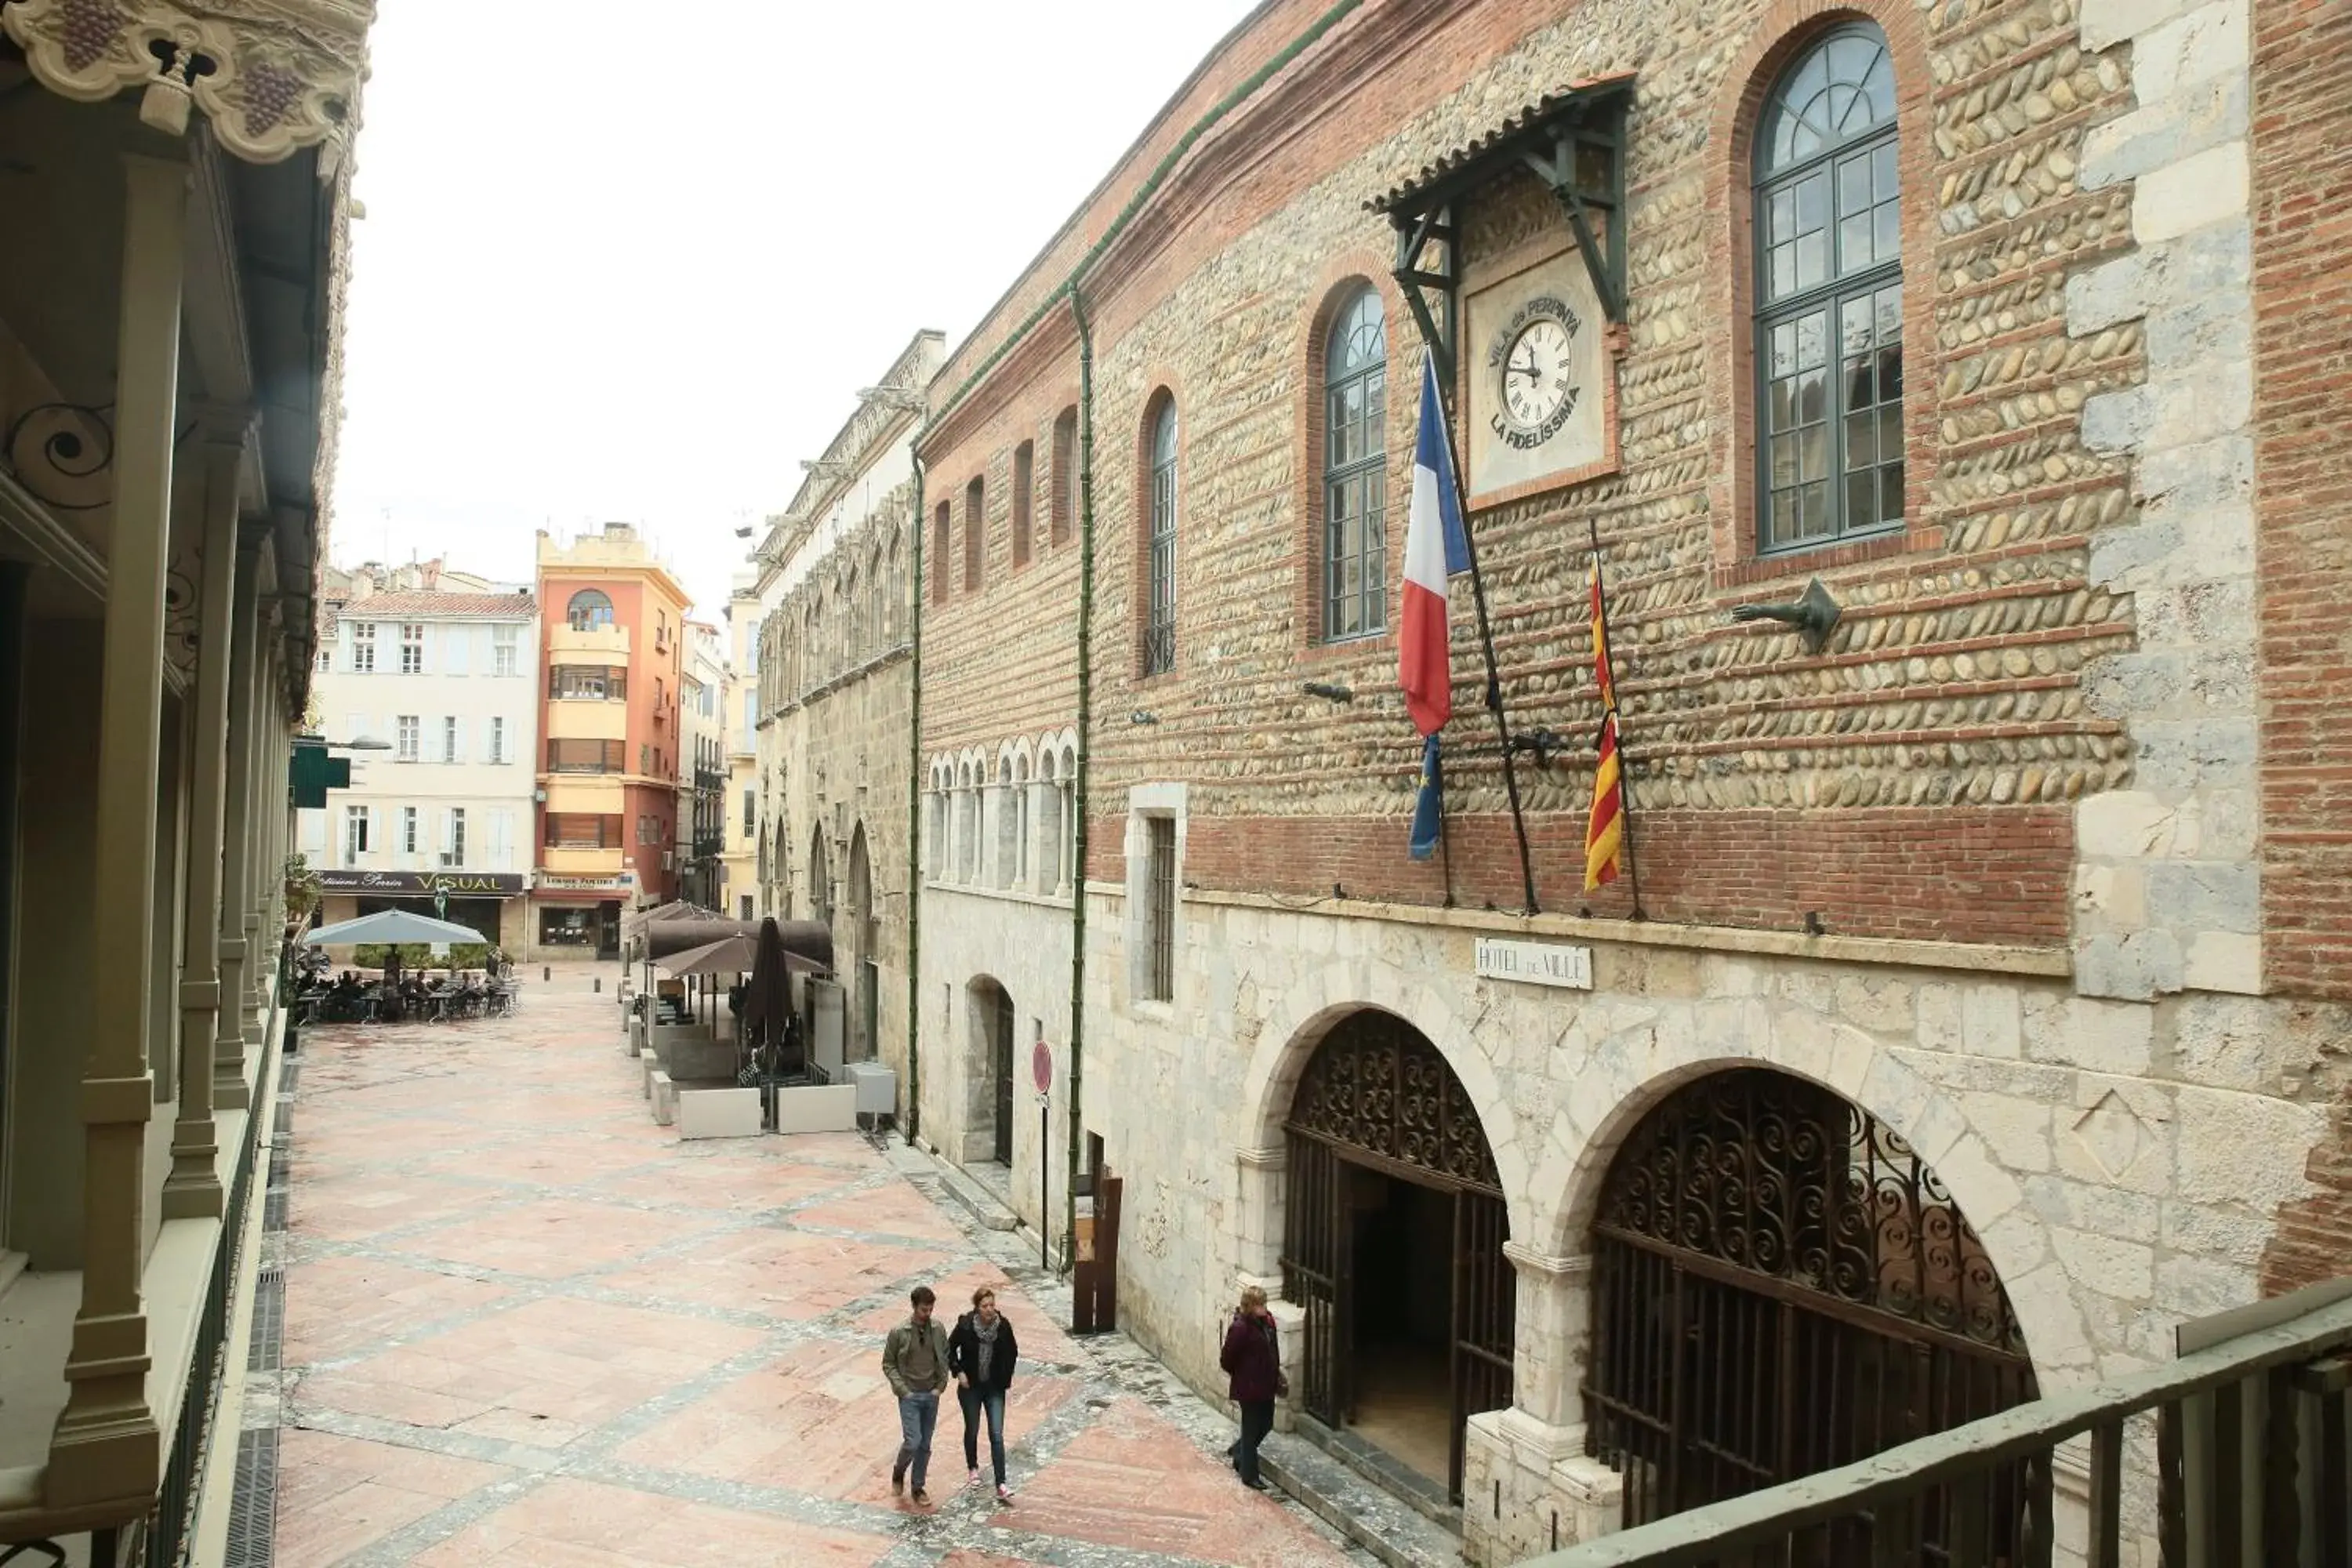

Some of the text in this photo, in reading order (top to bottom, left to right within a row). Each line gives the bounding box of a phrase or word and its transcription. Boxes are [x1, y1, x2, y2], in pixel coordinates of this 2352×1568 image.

[1490, 329, 1512, 368] VILA
[1512, 310, 1526, 328] de
[1490, 412, 1506, 440] LA
[414, 871, 504, 891] VISUAL
[1543, 952, 1584, 980] VILLE
